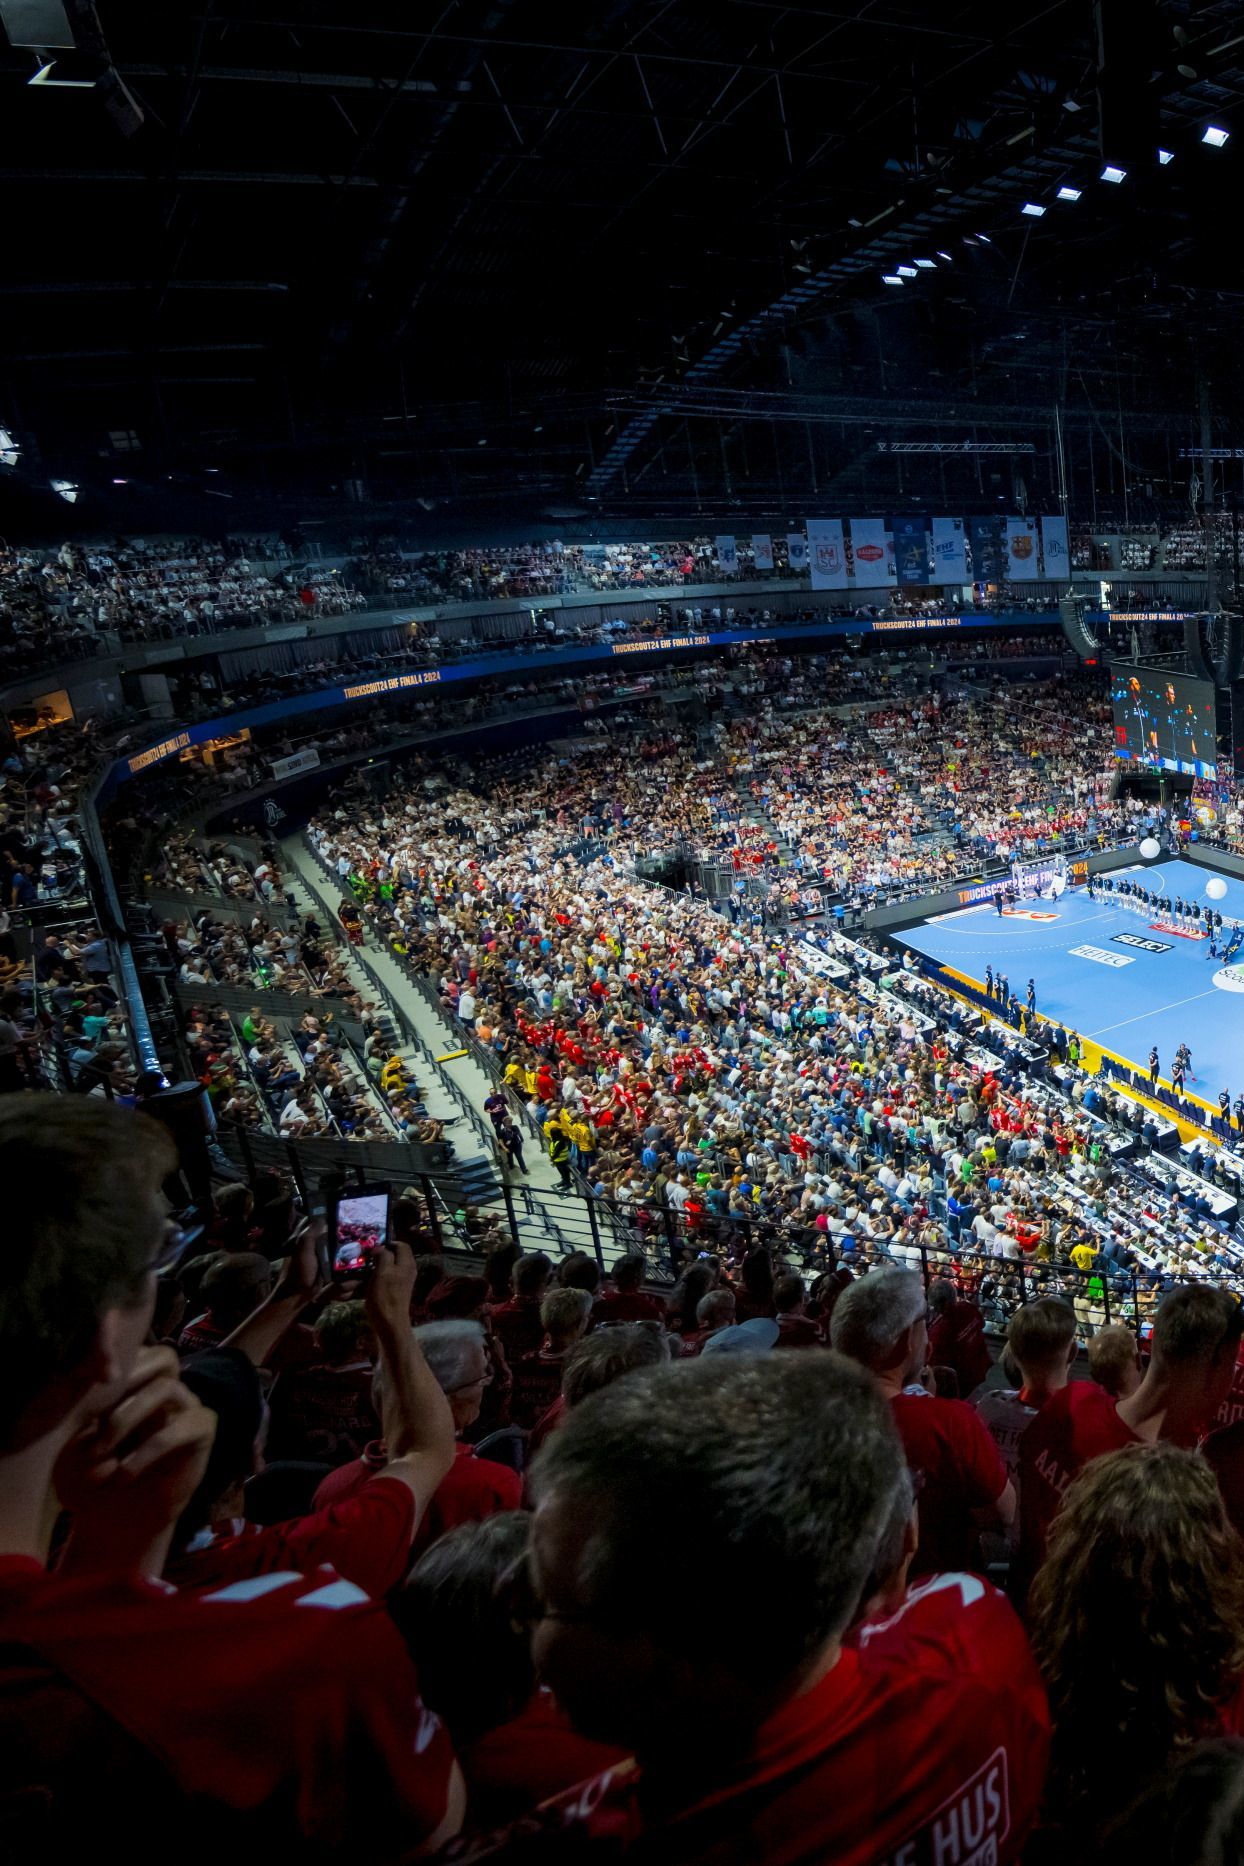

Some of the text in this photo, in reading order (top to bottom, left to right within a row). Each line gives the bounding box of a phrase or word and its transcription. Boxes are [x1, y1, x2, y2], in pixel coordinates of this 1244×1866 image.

[872, 618, 961, 631] TRUCKSCOUT24 EHF FINAL4 2024
[612, 635, 710, 654] TRUCKSCOUT24 EHF FINAL4 2024
[344, 671, 440, 699] TRUCKSCOUT24 EHF FINAL4 2024
[1026, 873, 1039, 887] EHF
[1073, 861, 1088, 875] 024
[1114, 933, 1174, 953] SELECT
[931, 1764, 1001, 1866] HUS
